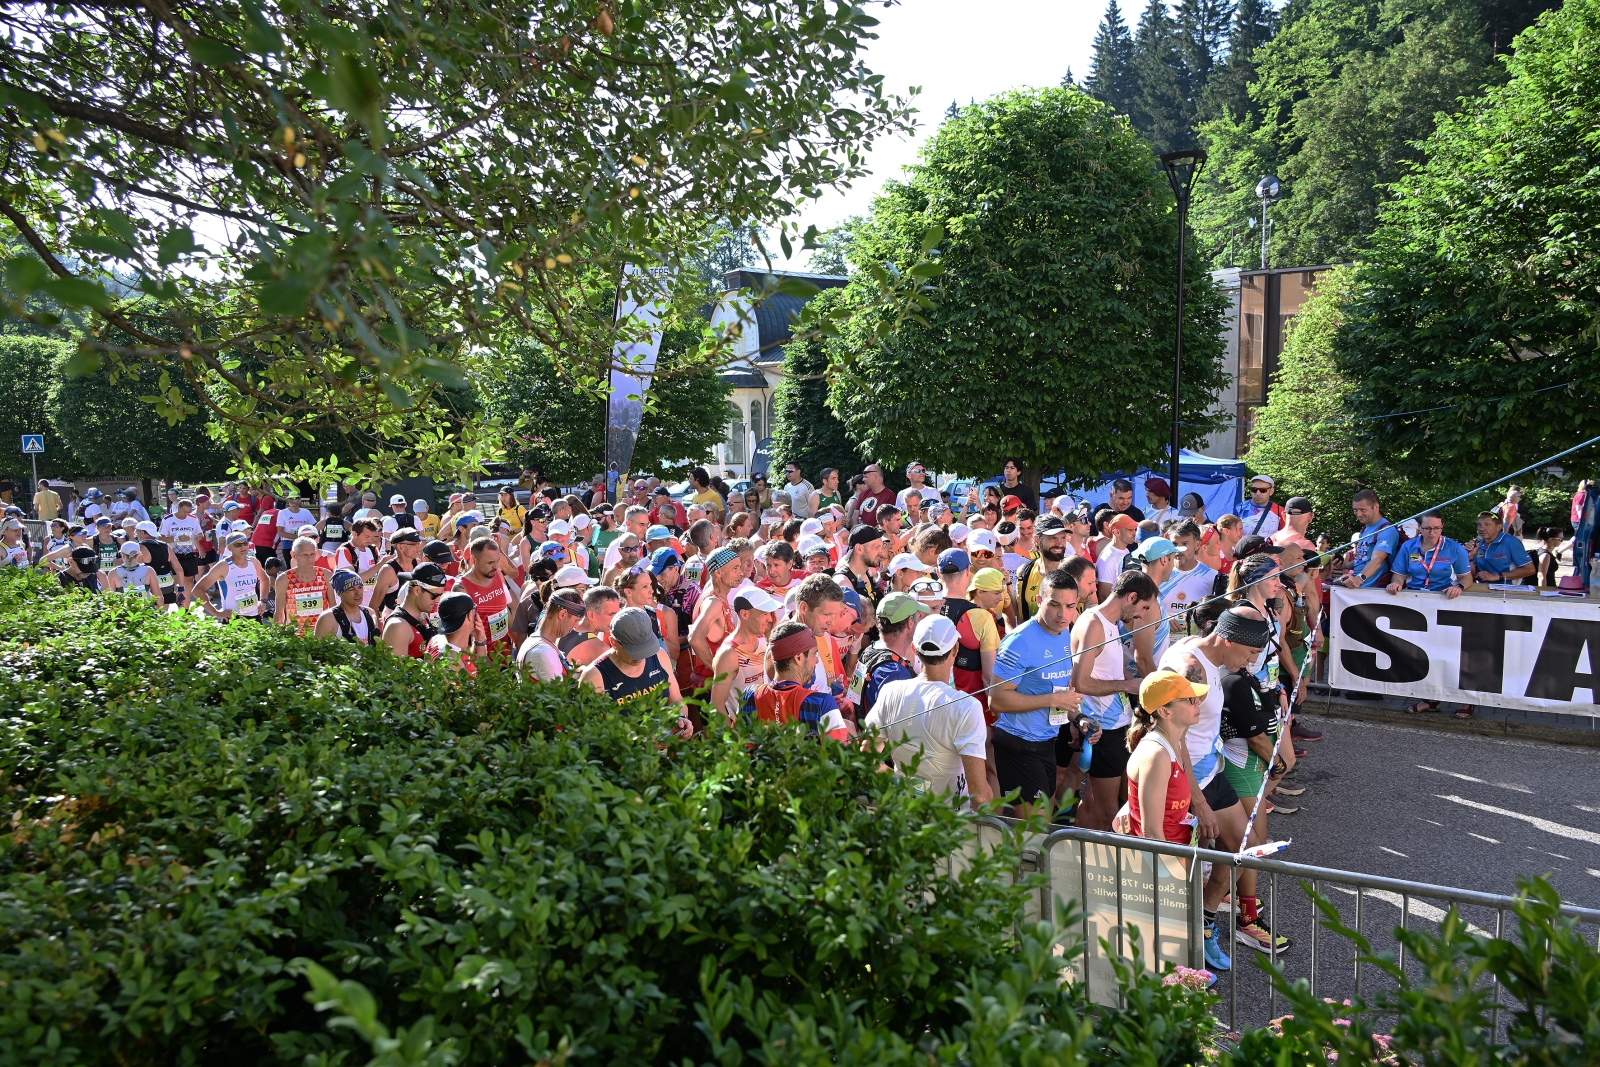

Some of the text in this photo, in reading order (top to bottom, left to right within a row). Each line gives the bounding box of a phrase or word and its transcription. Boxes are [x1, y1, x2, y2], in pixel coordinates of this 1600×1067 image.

[242, 598, 255, 606] 756
[302, 599, 318, 609] 339
[478, 587, 505, 604] AUSTRIA
[1340, 603, 1600, 705] STA
[907, 695, 919, 727] KPRUN
